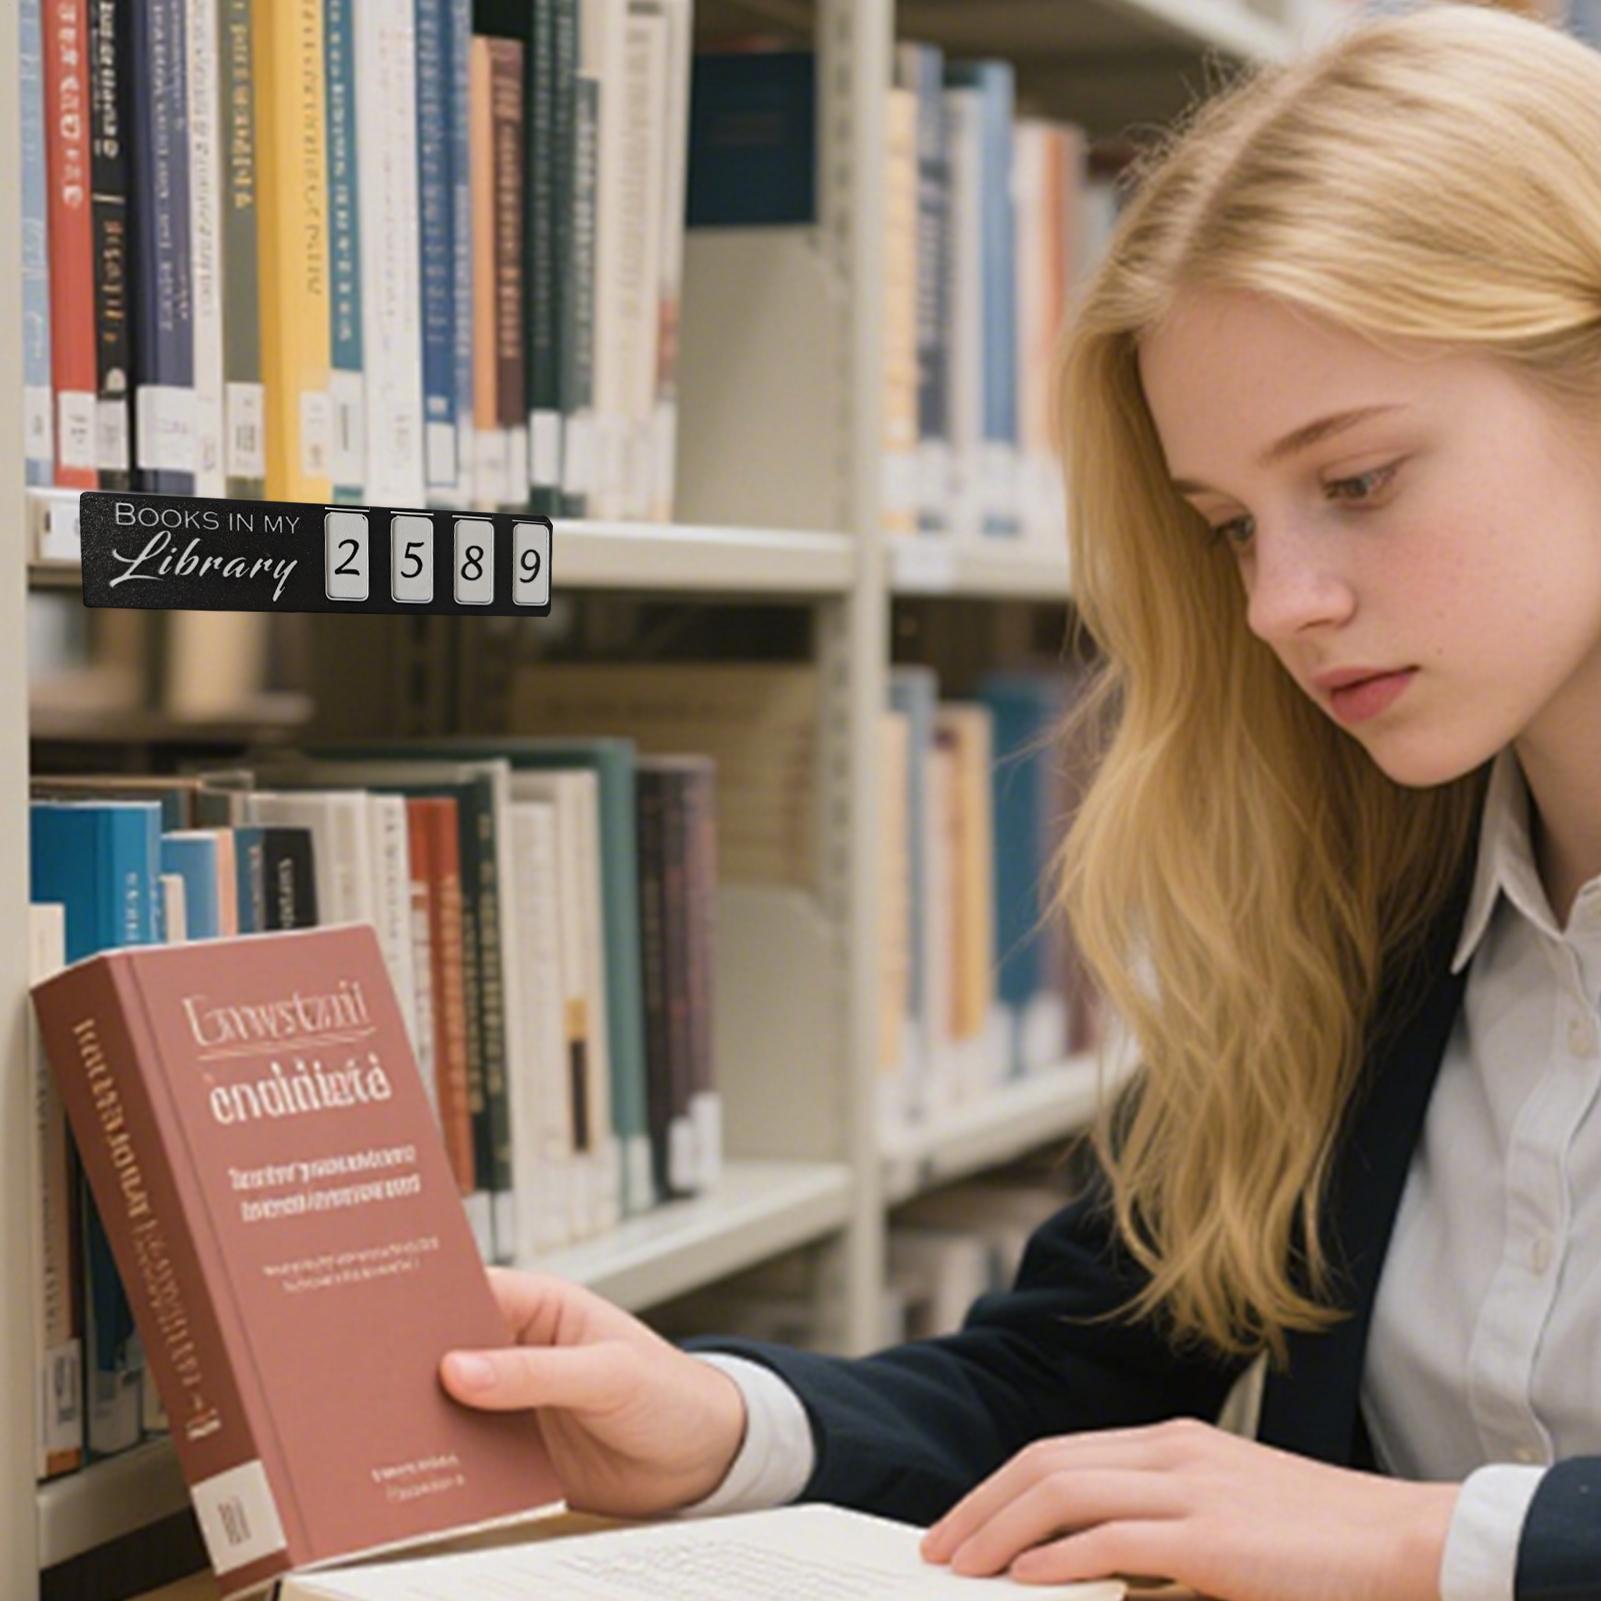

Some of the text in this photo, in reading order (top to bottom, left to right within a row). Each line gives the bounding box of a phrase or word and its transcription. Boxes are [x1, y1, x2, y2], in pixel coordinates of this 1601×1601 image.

[115, 502, 299, 534] BOOKS IN MY
[109, 530, 298, 603] Library
